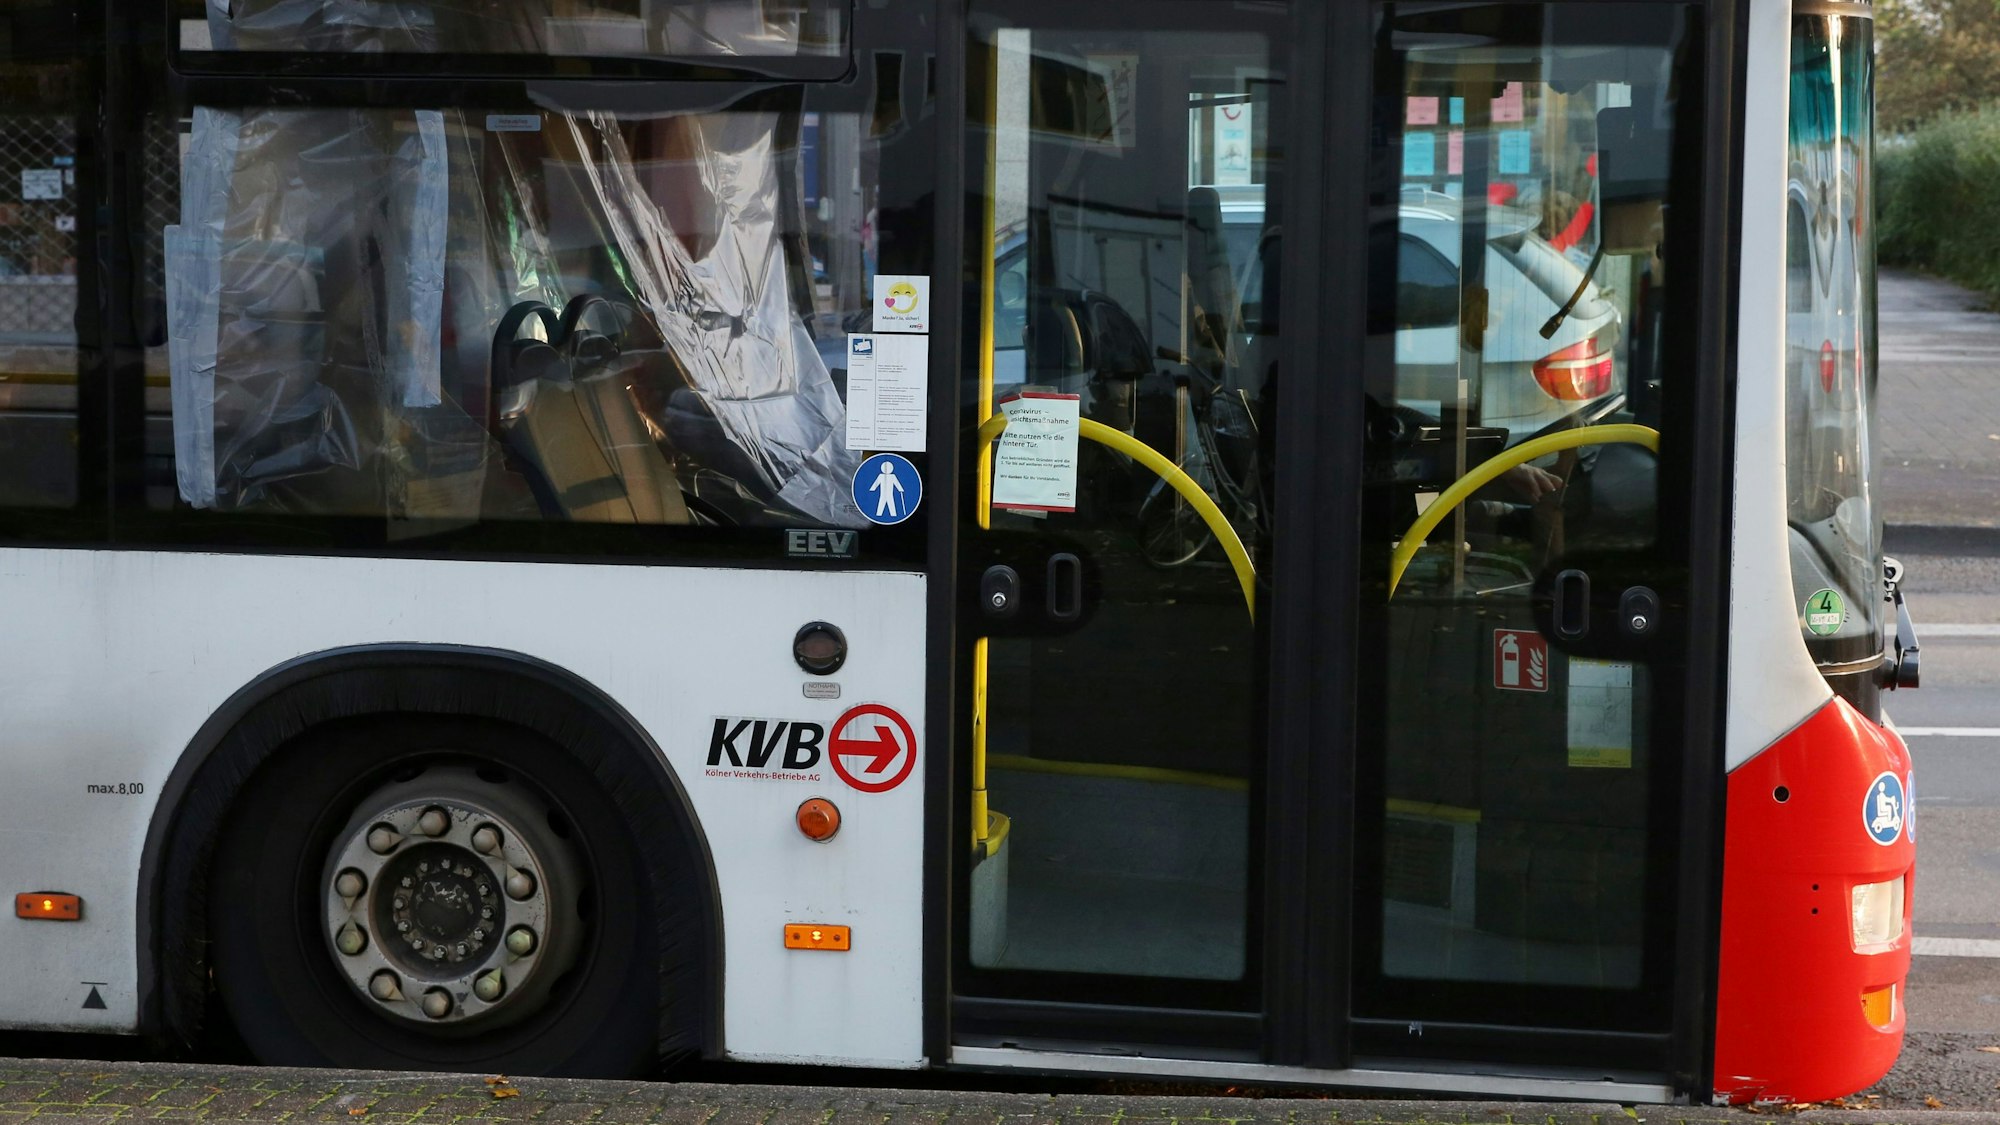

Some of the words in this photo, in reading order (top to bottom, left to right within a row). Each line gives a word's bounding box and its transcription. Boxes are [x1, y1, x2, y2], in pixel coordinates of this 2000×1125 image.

[1003, 440, 1025, 448] hintere
[788, 531, 853, 554] EEV
[1820, 592, 1832, 613] 4
[706, 718, 824, 770] KVB
[705, 768, 732, 778] Kölner
[733, 770, 807, 781] Verkehrs-Betriebe
[808, 773, 821, 782] AG
[87, 782, 144, 796] max.8,00
